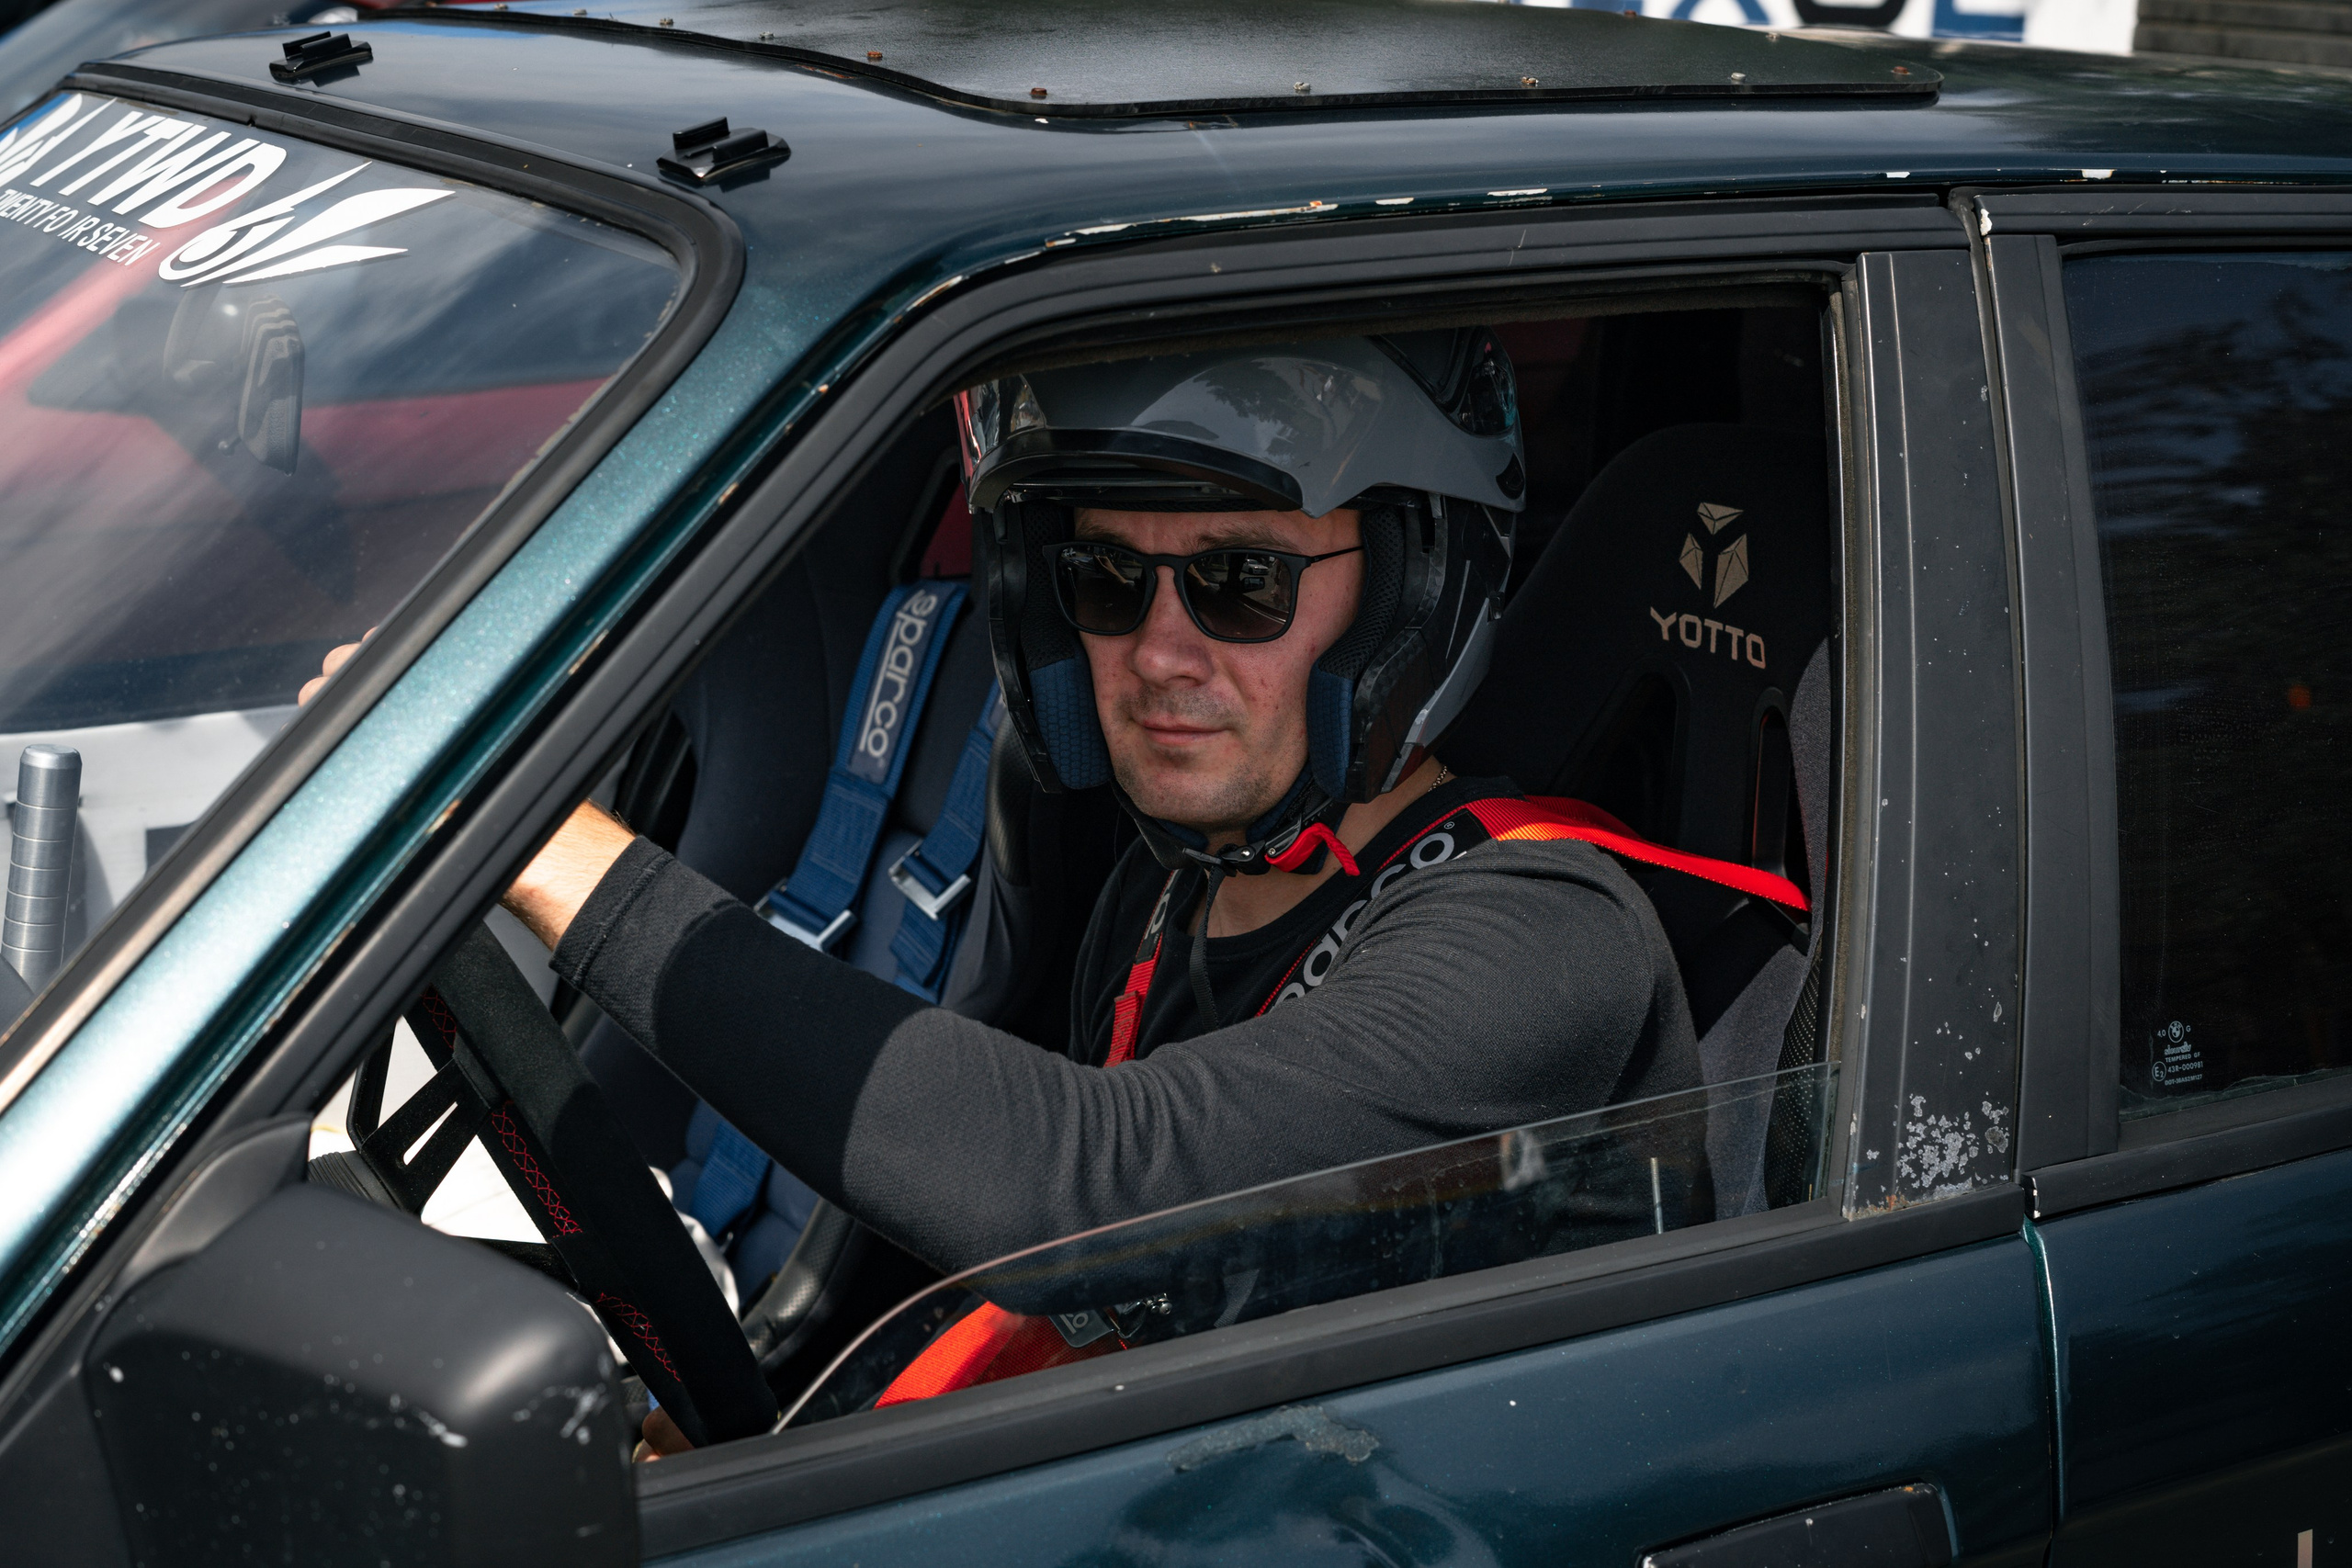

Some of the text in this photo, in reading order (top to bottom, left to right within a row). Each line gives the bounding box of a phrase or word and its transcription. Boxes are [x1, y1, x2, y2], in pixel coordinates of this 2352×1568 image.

[77, 222, 161, 266] SEVEN
[1650, 606, 1766, 670] YOTTO
[866, 589, 937, 759] sparco
[2154, 1066, 2165, 1078] E2
[2165, 1054, 2192, 1063] TEMPERED
[2168, 1061, 2203, 1073] 43R-000981
